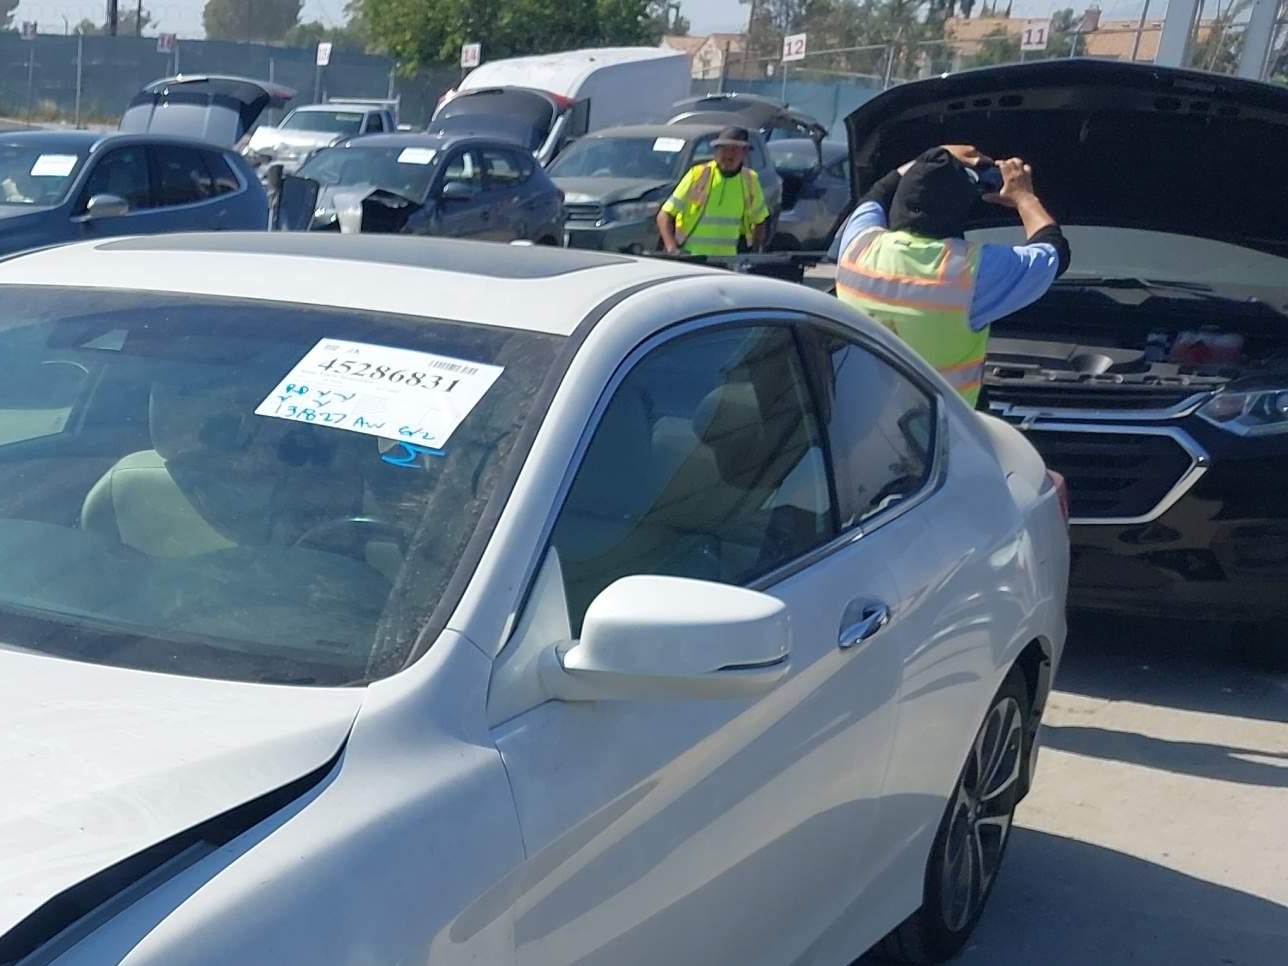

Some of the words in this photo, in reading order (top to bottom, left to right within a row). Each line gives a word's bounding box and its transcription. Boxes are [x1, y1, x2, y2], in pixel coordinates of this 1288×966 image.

[1024, 28, 1045, 45] 11
[785, 40, 804, 56] 12
[317, 357, 461, 393] 45286831
